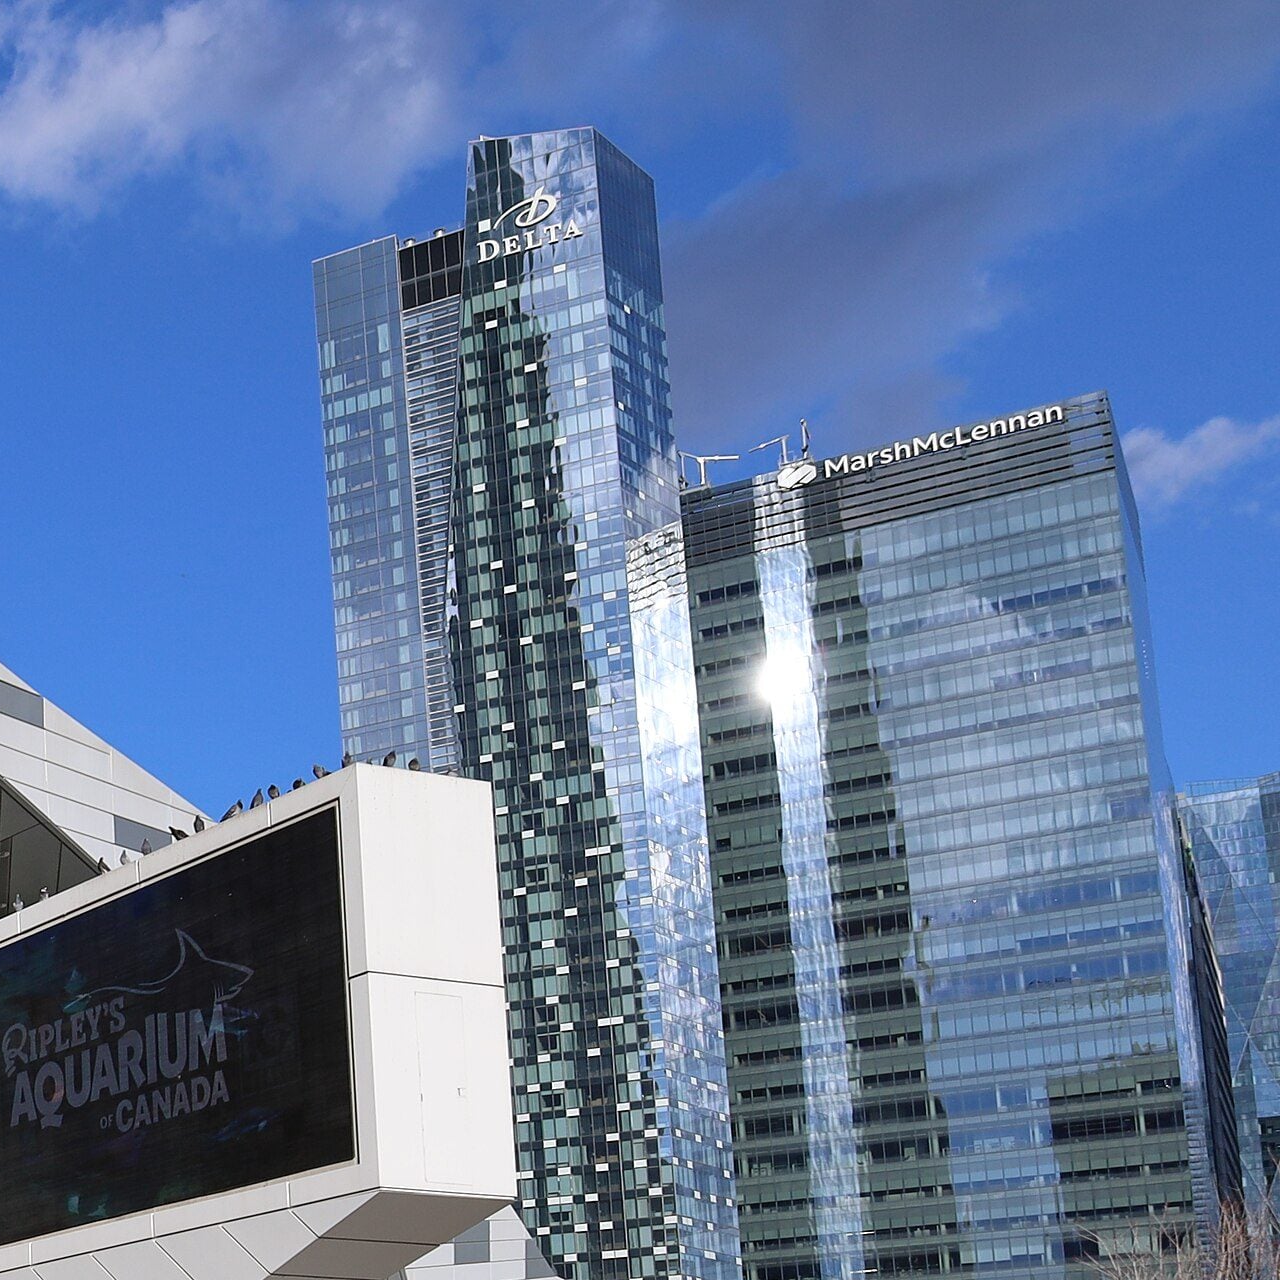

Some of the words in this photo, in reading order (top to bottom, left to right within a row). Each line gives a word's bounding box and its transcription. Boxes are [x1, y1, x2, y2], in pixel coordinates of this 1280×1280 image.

[477, 219, 584, 264] DELTA
[824, 405, 1063, 478] MarshMcLennan
[10, 1002, 228, 1129] AQUARIUM
[100, 1114, 115, 1130] OF
[115, 1070, 231, 1133] CANADA
